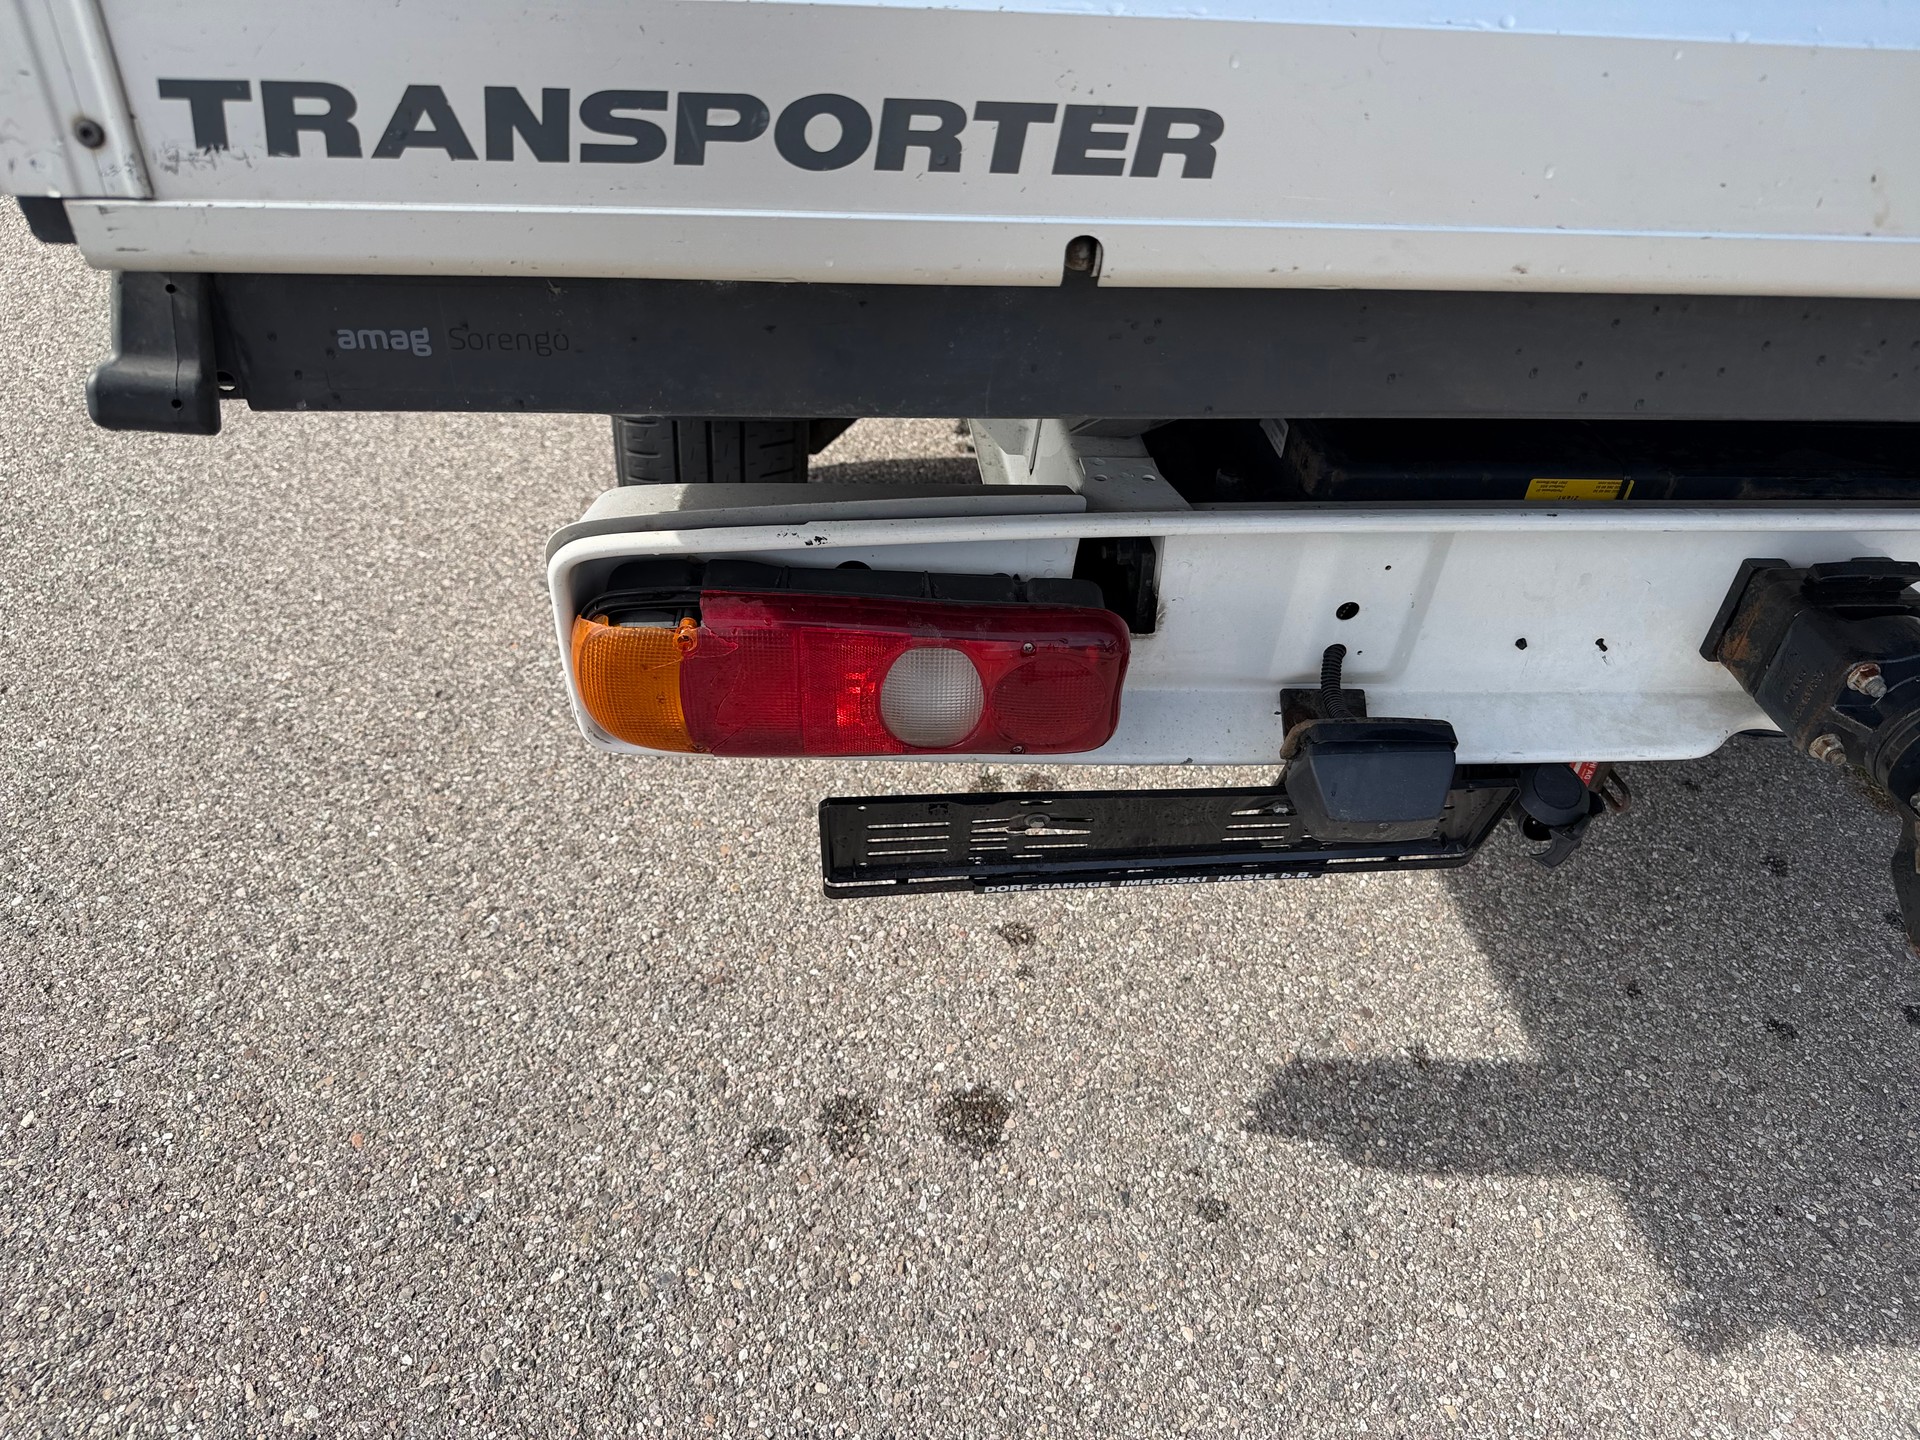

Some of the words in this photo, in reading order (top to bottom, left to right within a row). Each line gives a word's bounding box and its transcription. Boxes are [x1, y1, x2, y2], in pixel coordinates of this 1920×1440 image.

[157, 78, 1225, 179] TRANSPORTER
[337, 327, 433, 357] amag
[448, 328, 570, 357] Sorengo
[984, 881, 1111, 893] DORF-GARAGE
[1119, 876, 1208, 887] IMEROSKI
[1217, 873, 1276, 882] HASLE
